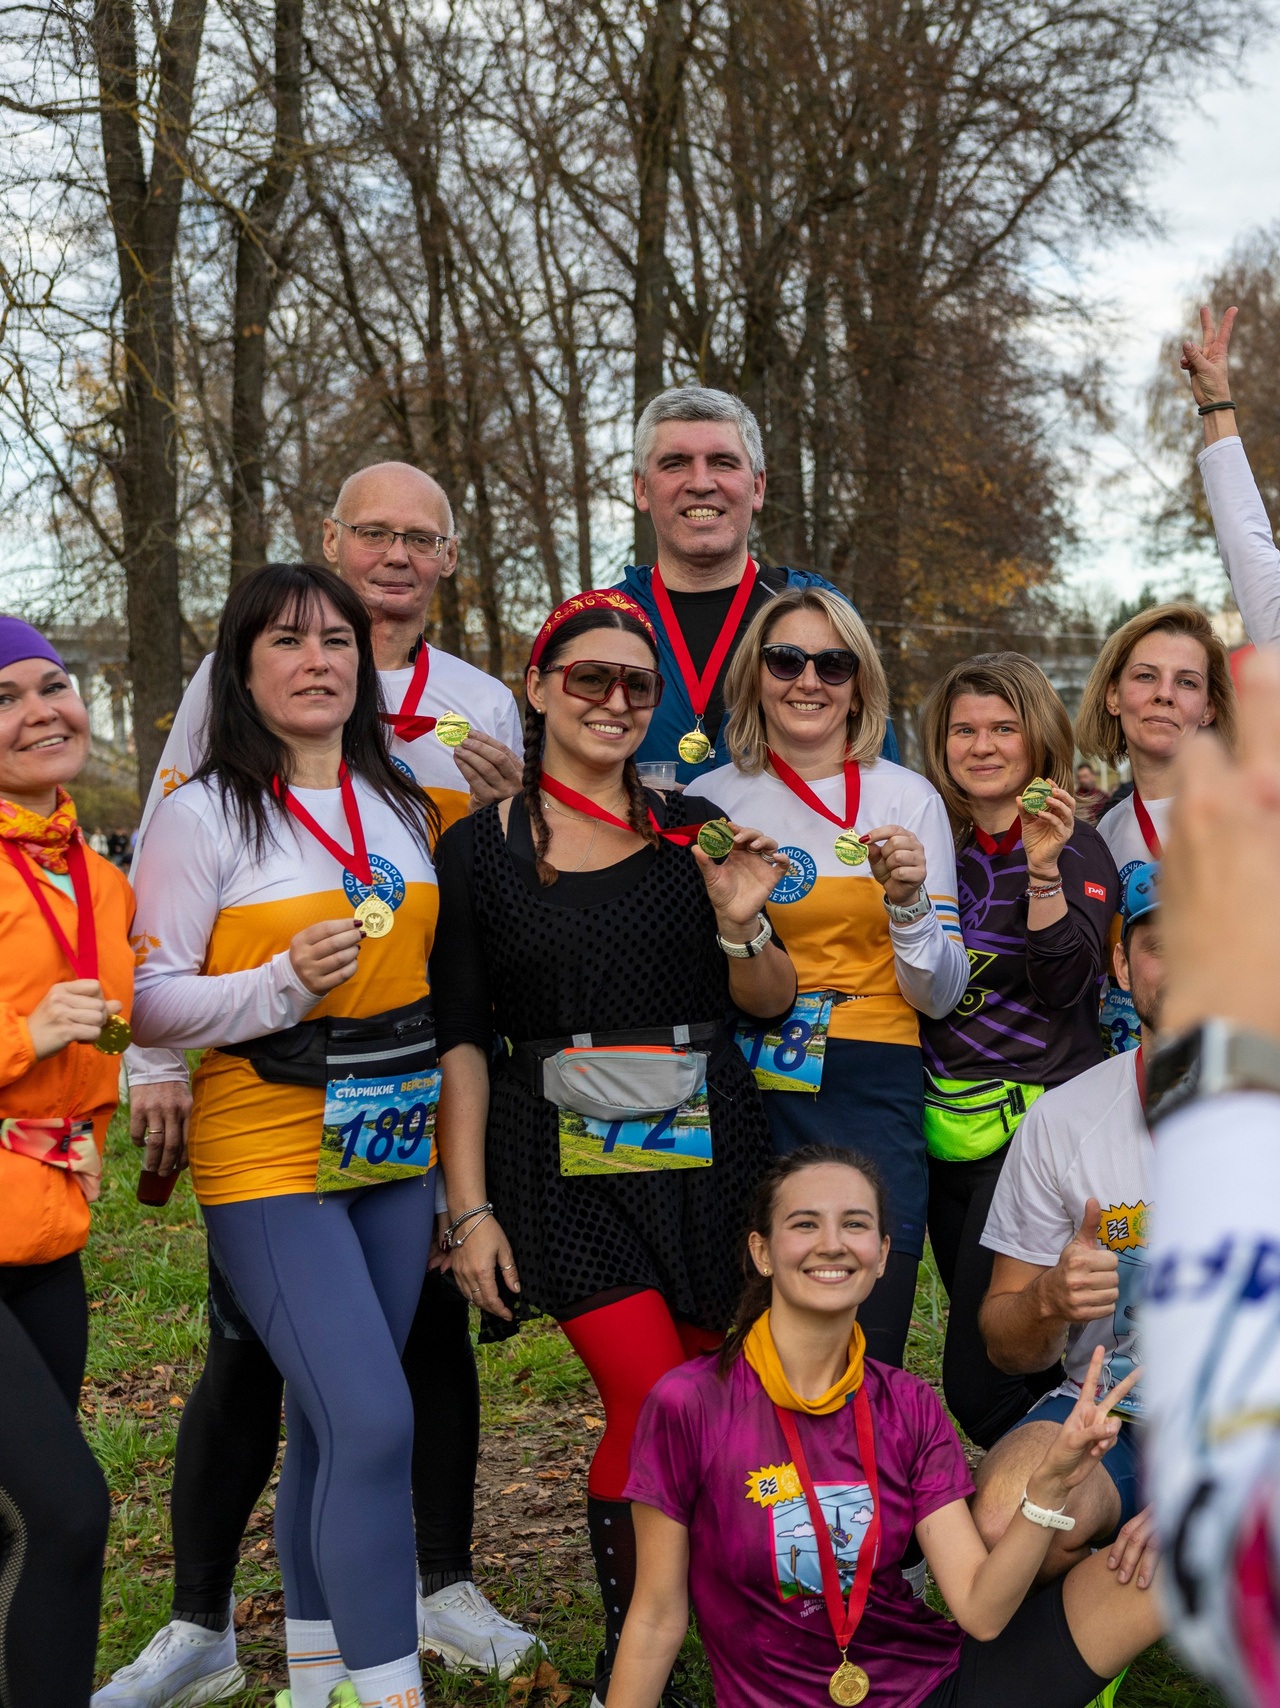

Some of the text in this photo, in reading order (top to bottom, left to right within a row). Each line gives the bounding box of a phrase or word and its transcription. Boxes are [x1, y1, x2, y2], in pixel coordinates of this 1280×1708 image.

[1109, 994, 1135, 1009] СТАРИЦ
[335, 1077, 435, 1099] СТАРИЦКИЕ ВЕРСТЫ
[339, 1102, 428, 1170] 189
